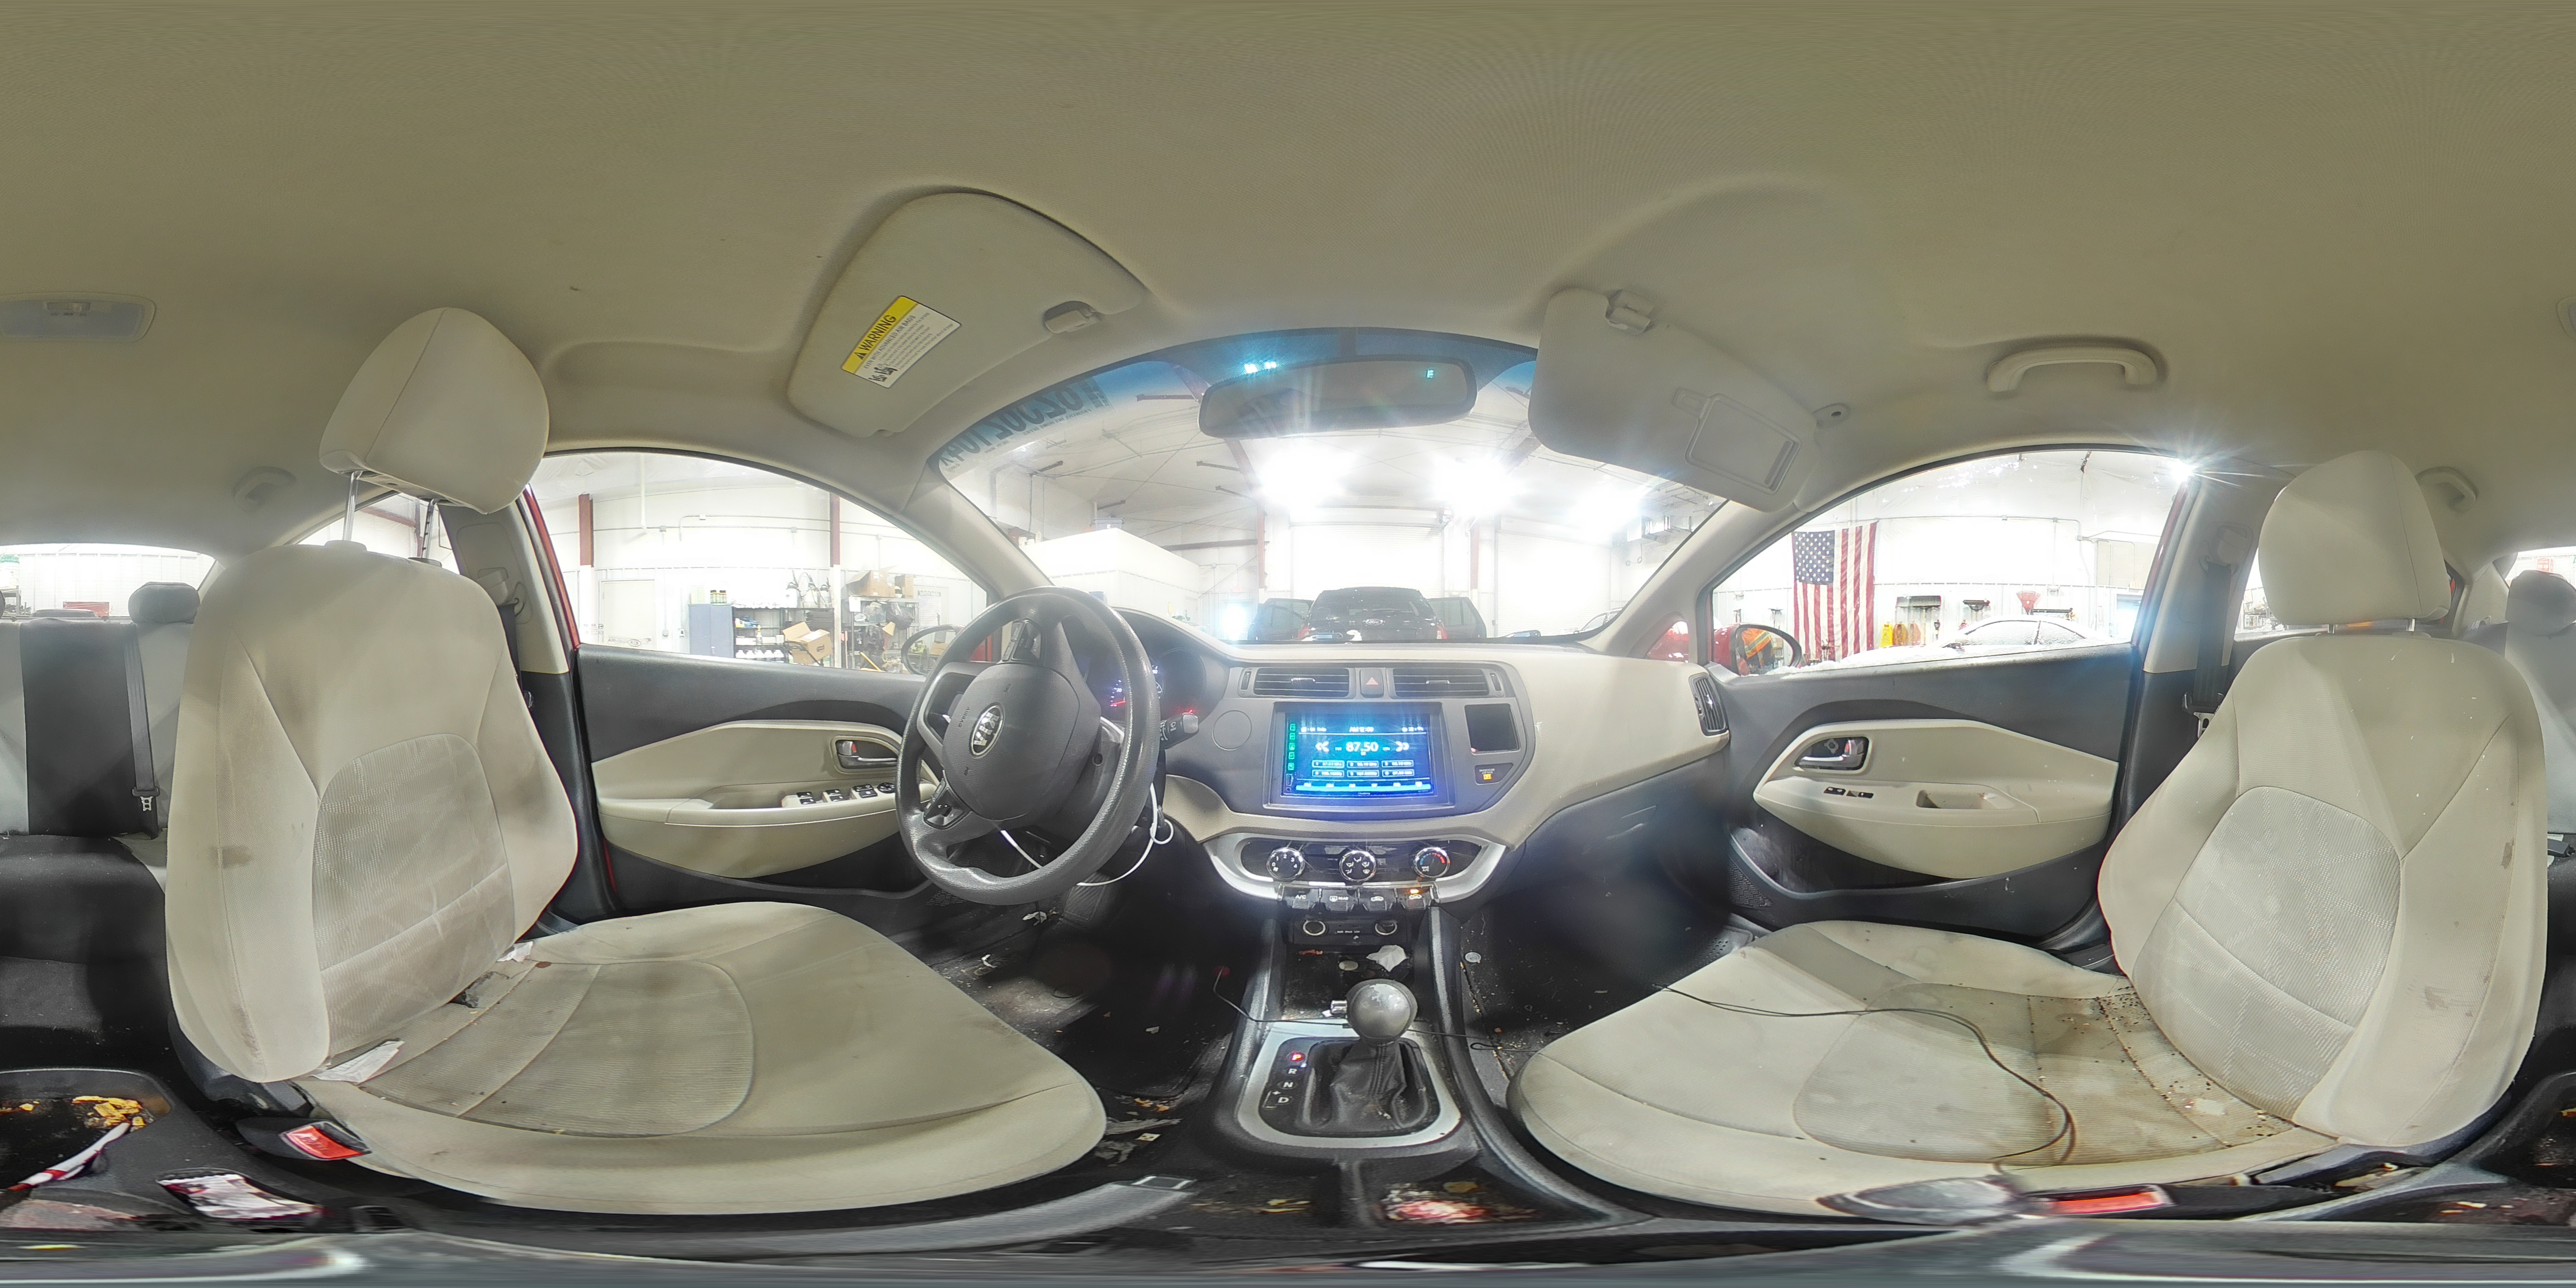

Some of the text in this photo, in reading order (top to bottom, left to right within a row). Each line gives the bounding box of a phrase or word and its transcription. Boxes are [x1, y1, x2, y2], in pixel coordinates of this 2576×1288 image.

[860, 314, 897, 351] WARNING
[863, 315, 916, 369] EVEN WITH ADVANCED AIR BAGS
[1427, 369, 1434, 378] E
[973, 712, 1000, 746] KIA
[1346, 741, 1379, 752] 87.50
